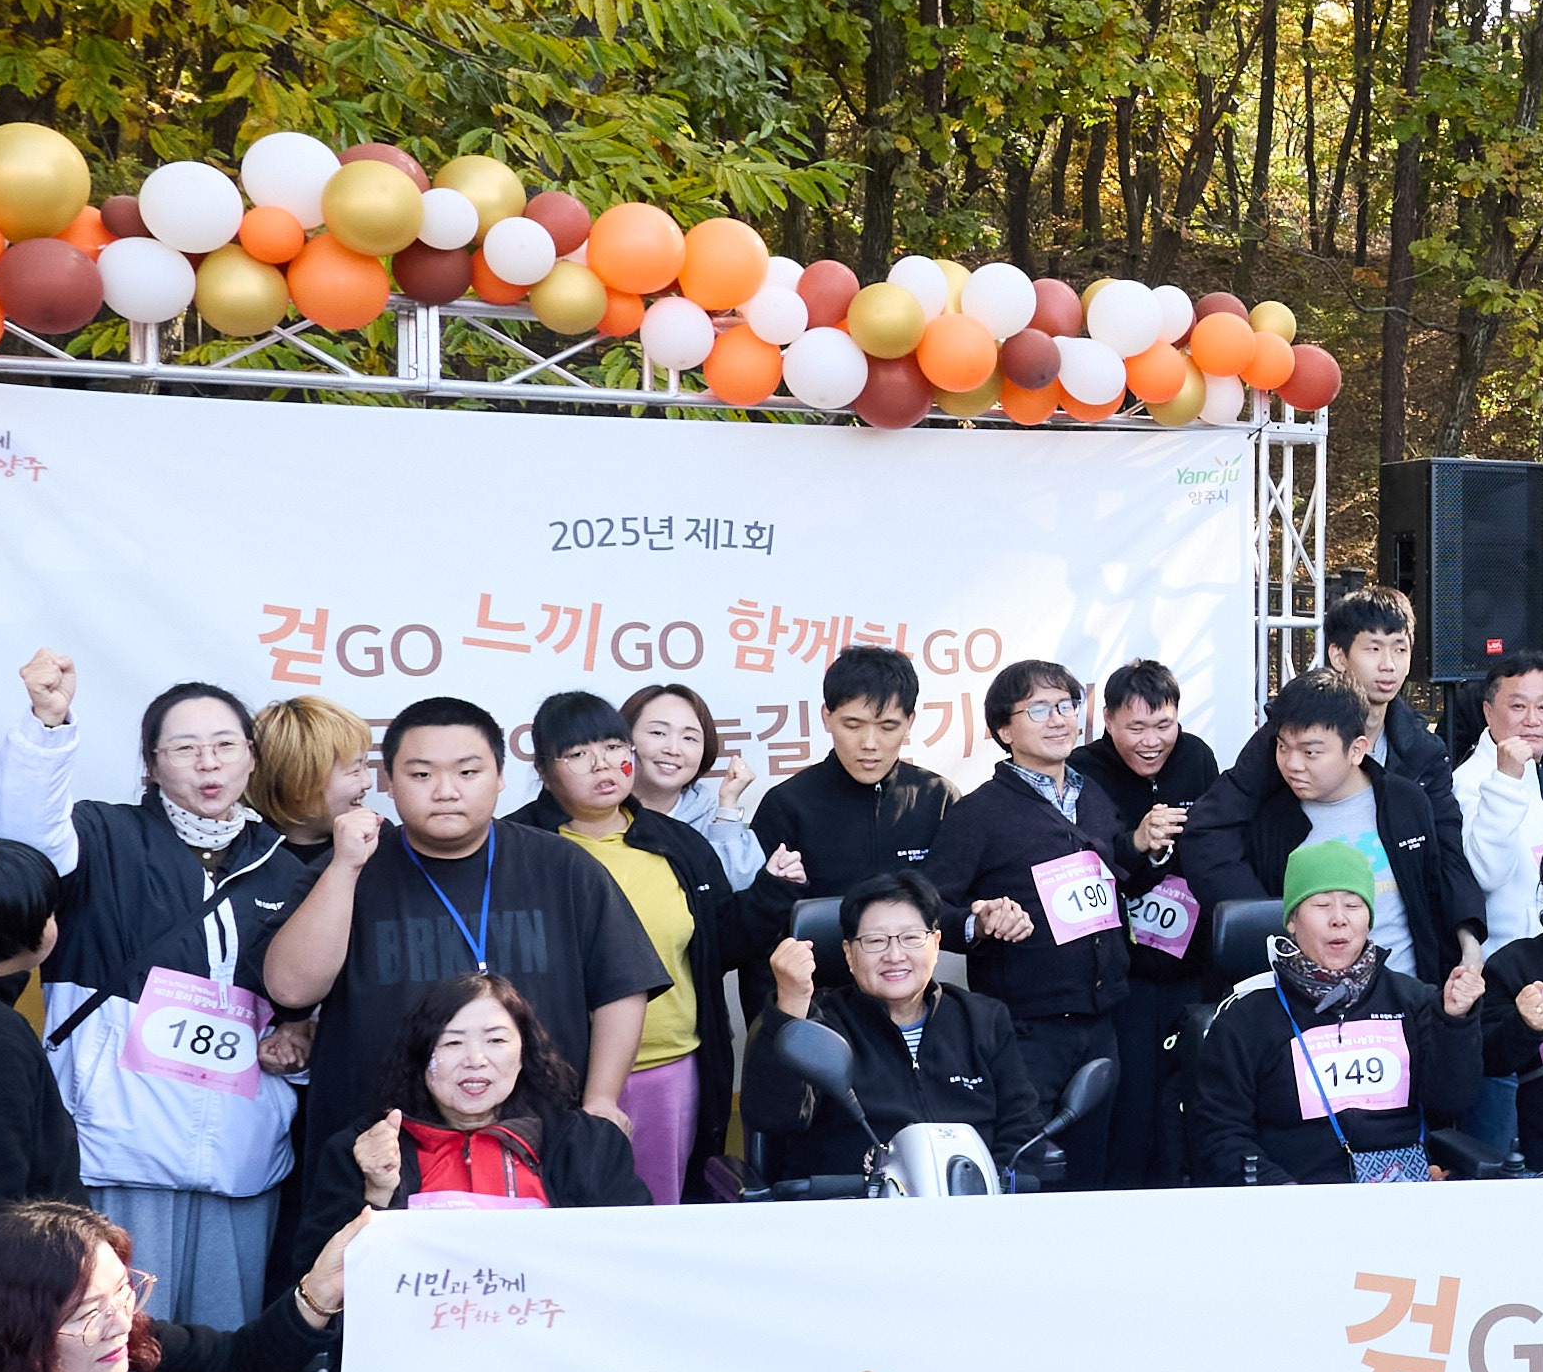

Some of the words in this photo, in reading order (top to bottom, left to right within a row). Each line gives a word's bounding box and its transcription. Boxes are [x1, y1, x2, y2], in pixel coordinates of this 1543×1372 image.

[1188, 488, 1229, 506] 양주시
[548, 515, 675, 552] 2025년
[683, 517, 775, 556] 제1회
[258, 603, 443, 686] 걷GO
[461, 592, 704, 673] 느끼GO
[1067, 883, 1107, 913] 190
[1127, 896, 1177, 930] 200
[168, 1018, 241, 1061] 188
[1324, 1056, 1384, 1088] 149
[395, 1268, 471, 1297] 시민과
[472, 1267, 526, 1296] 함께
[430, 1299, 502, 1330] 도약하는
[506, 1297, 566, 1329] 양주
